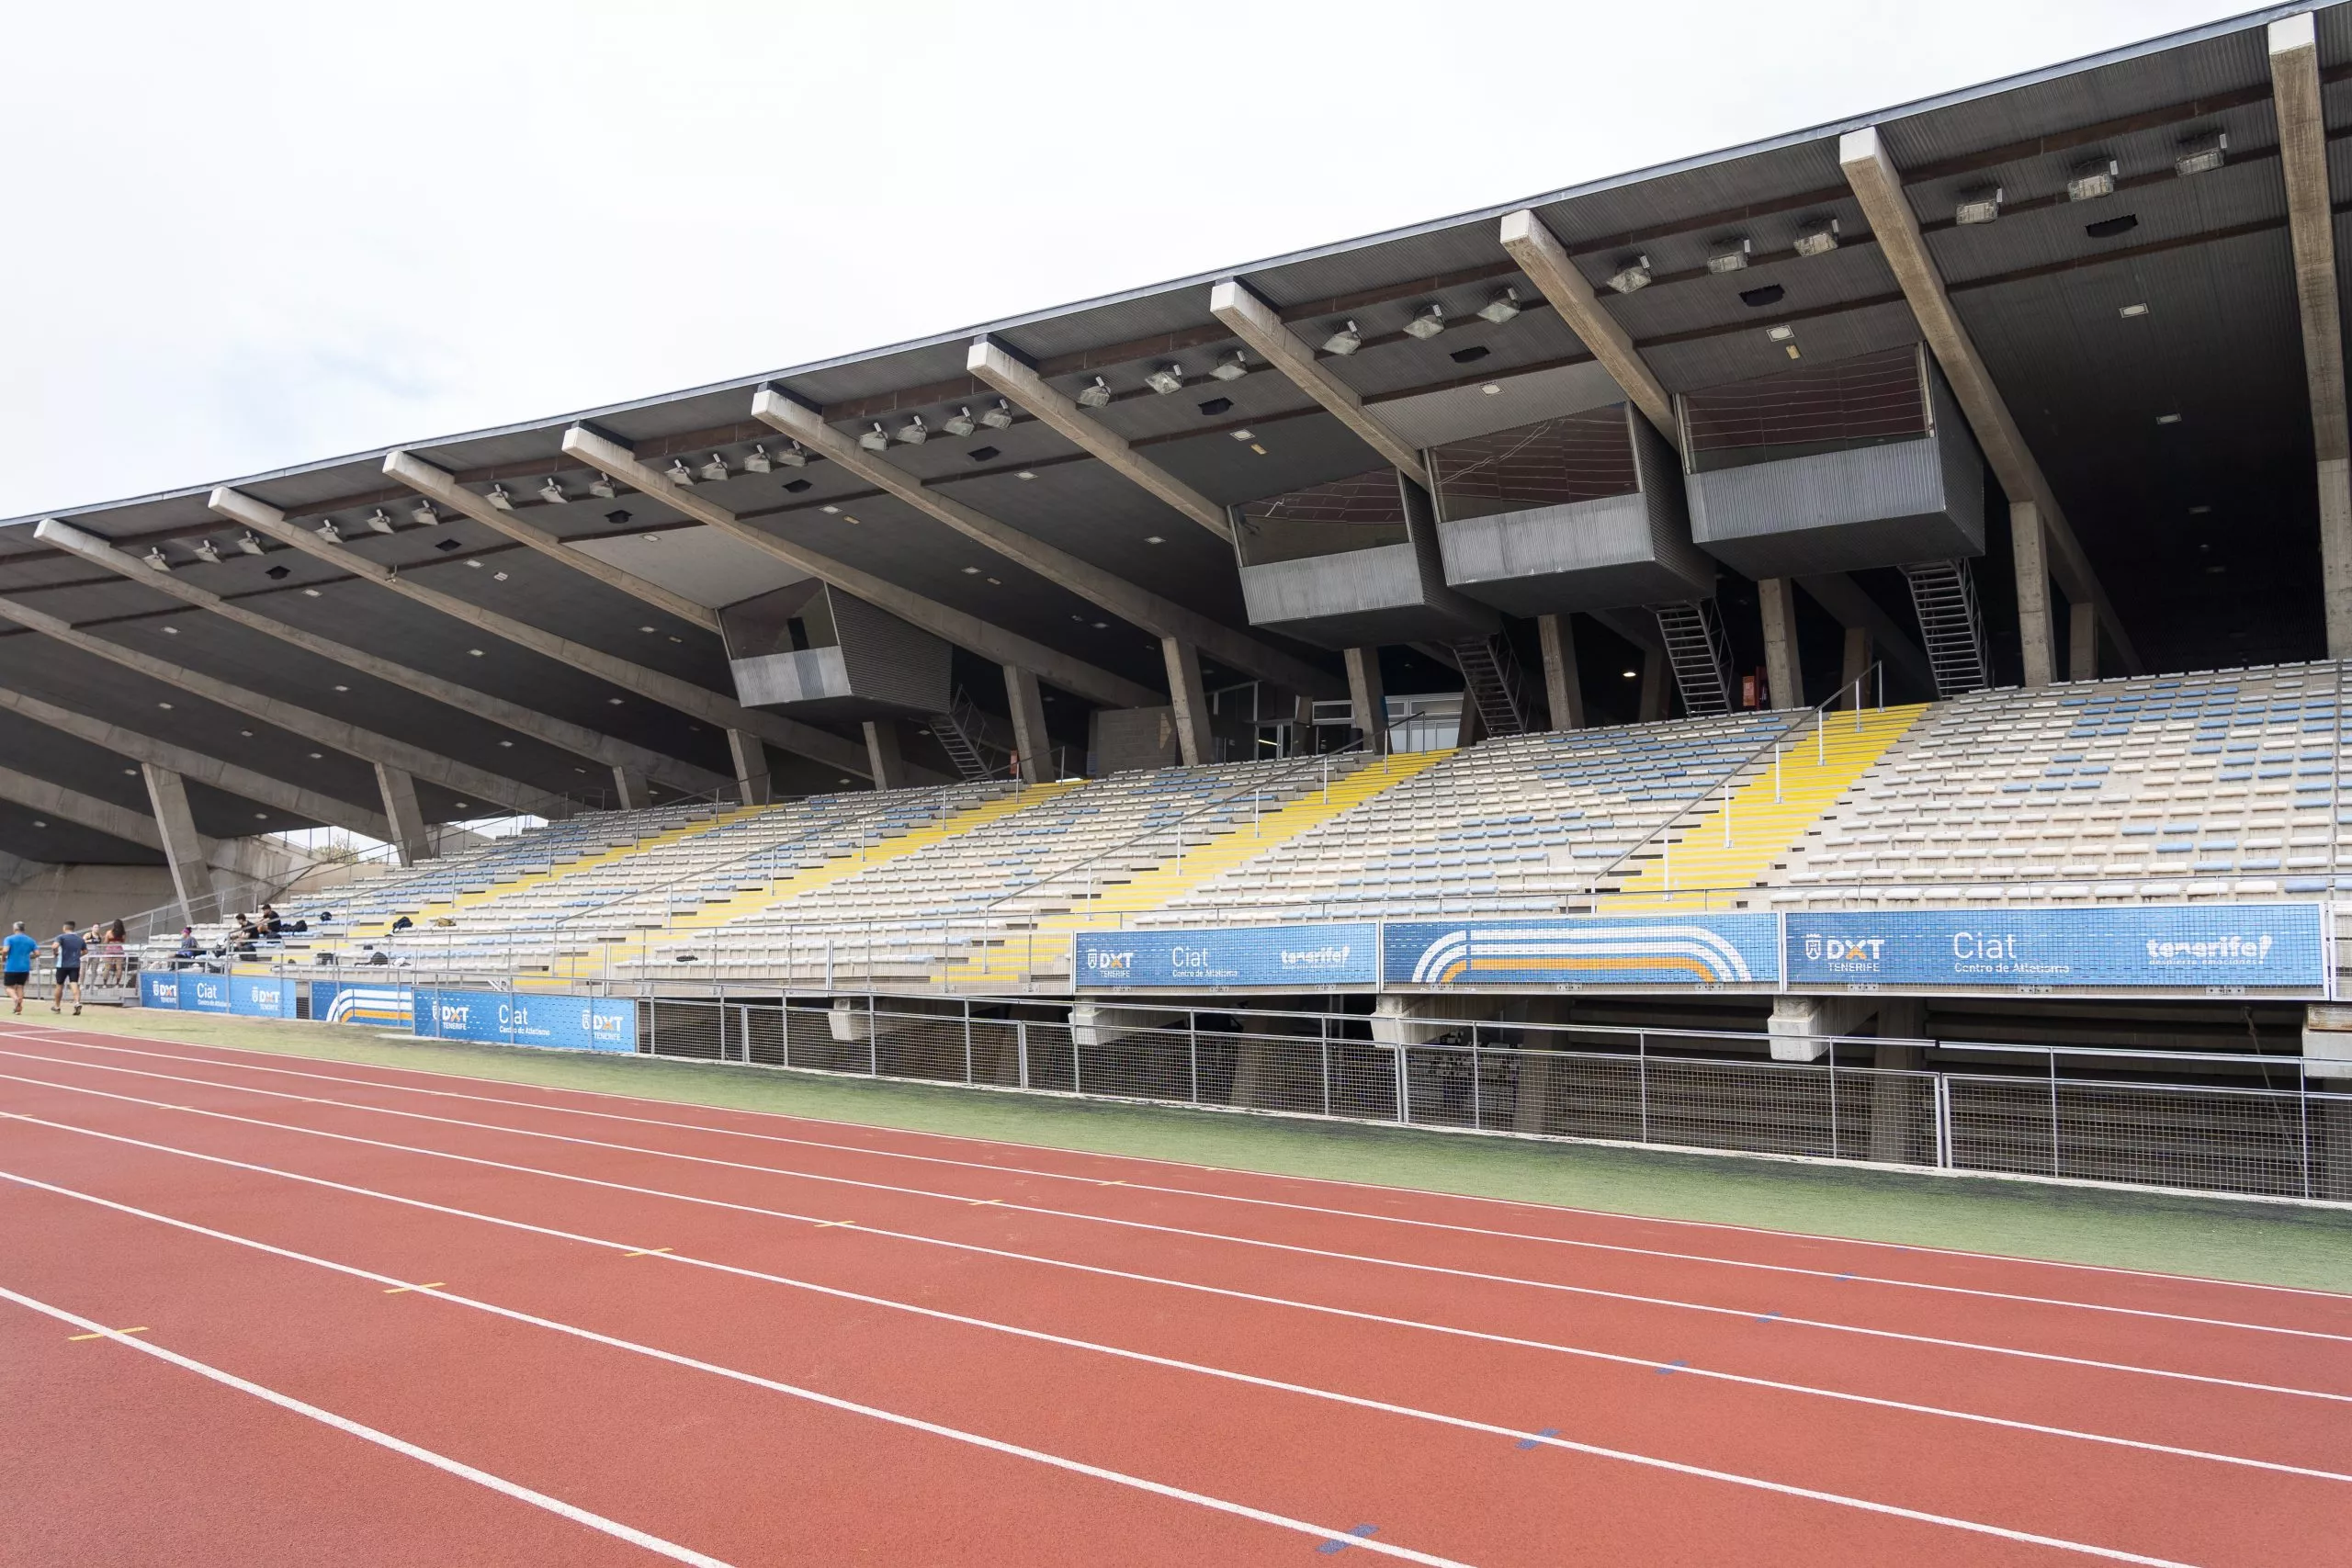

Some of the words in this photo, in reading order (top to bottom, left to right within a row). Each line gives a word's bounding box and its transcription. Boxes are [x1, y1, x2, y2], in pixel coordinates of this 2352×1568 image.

[1826, 939, 1884, 960] DXT
[1953, 931, 2017, 958] Ciat
[1100, 952, 1134, 968] DXT
[1172, 946, 1208, 967] Ciat
[1828, 962, 1880, 972] TENERIFE
[1954, 962, 1993, 973] Centro
[1996, 963, 2009, 973] de
[2012, 962, 2070, 973] Atletismo
[197, 983, 217, 998] Ciat
[259, 991, 280, 1003] DXT
[442, 1006, 469, 1021] DXT
[499, 1005, 528, 1024] Cat
[593, 1014, 623, 1032] DXT
